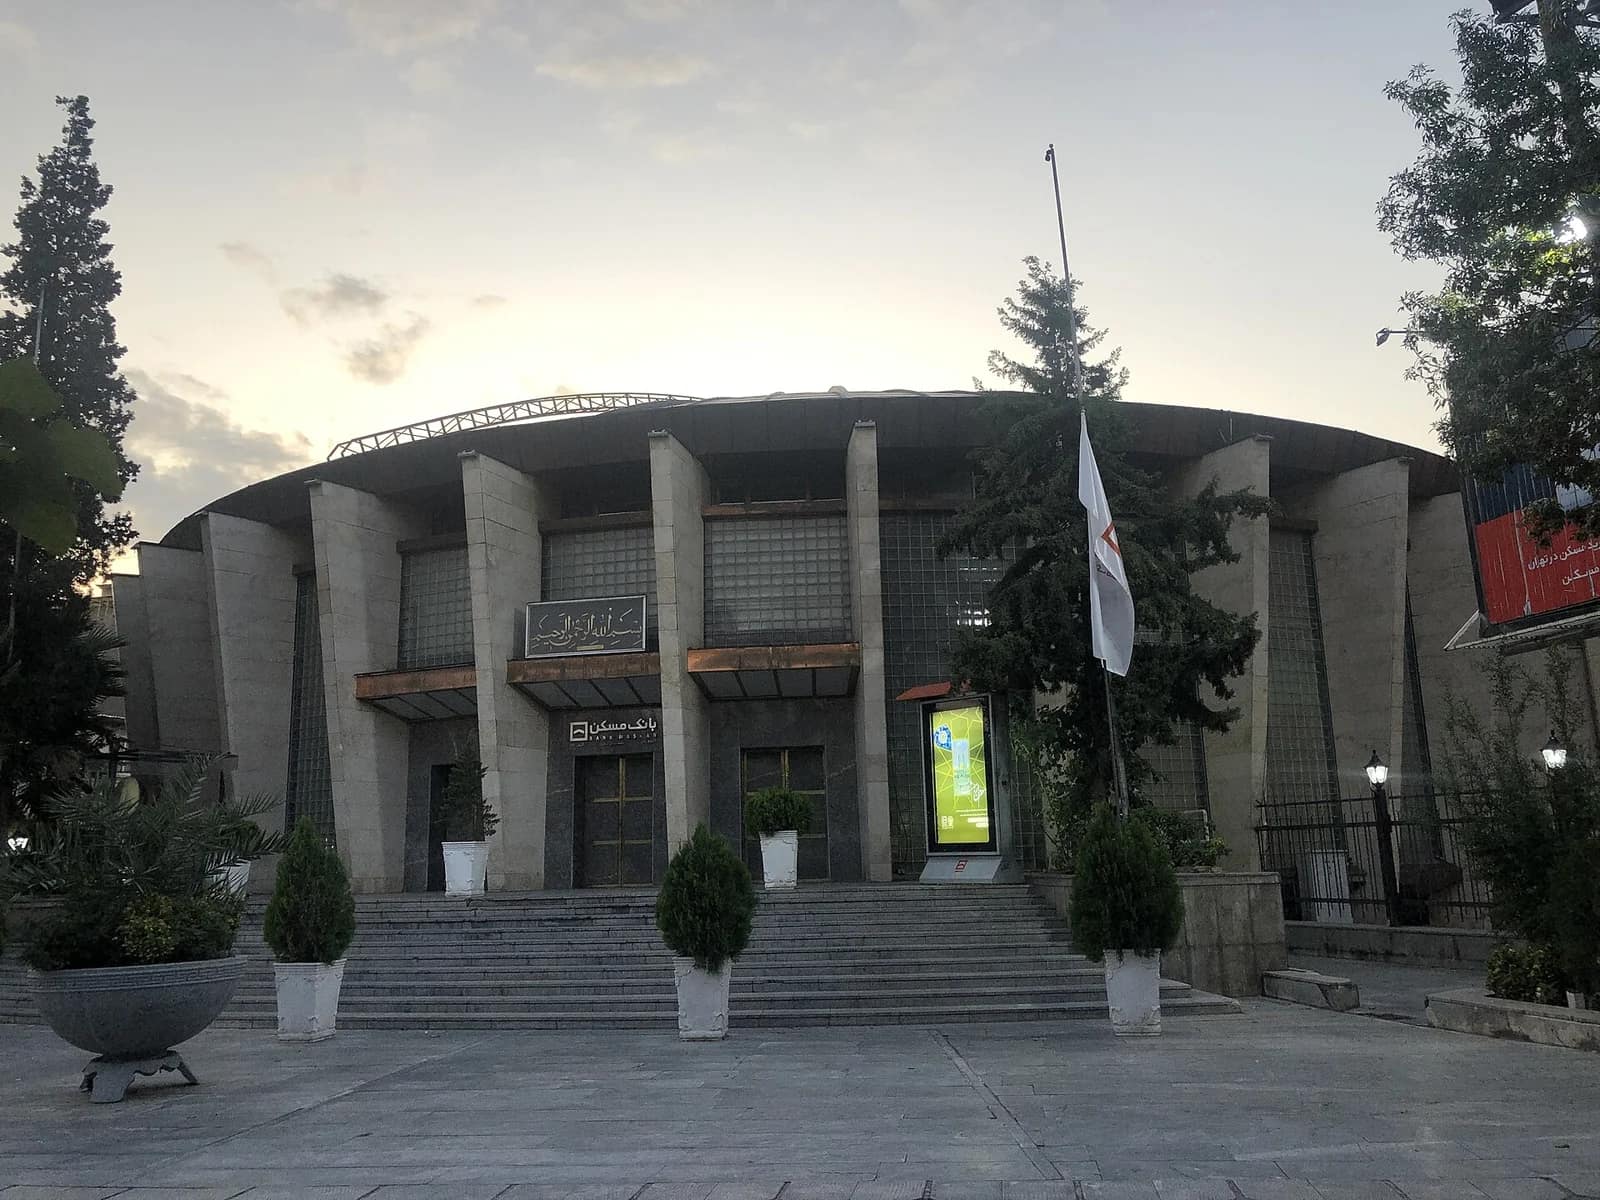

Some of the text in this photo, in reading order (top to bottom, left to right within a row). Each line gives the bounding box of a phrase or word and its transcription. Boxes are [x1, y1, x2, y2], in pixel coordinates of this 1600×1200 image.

[1528, 554, 1549, 570] تهران
[589, 717, 657, 735] بانک مسکن
